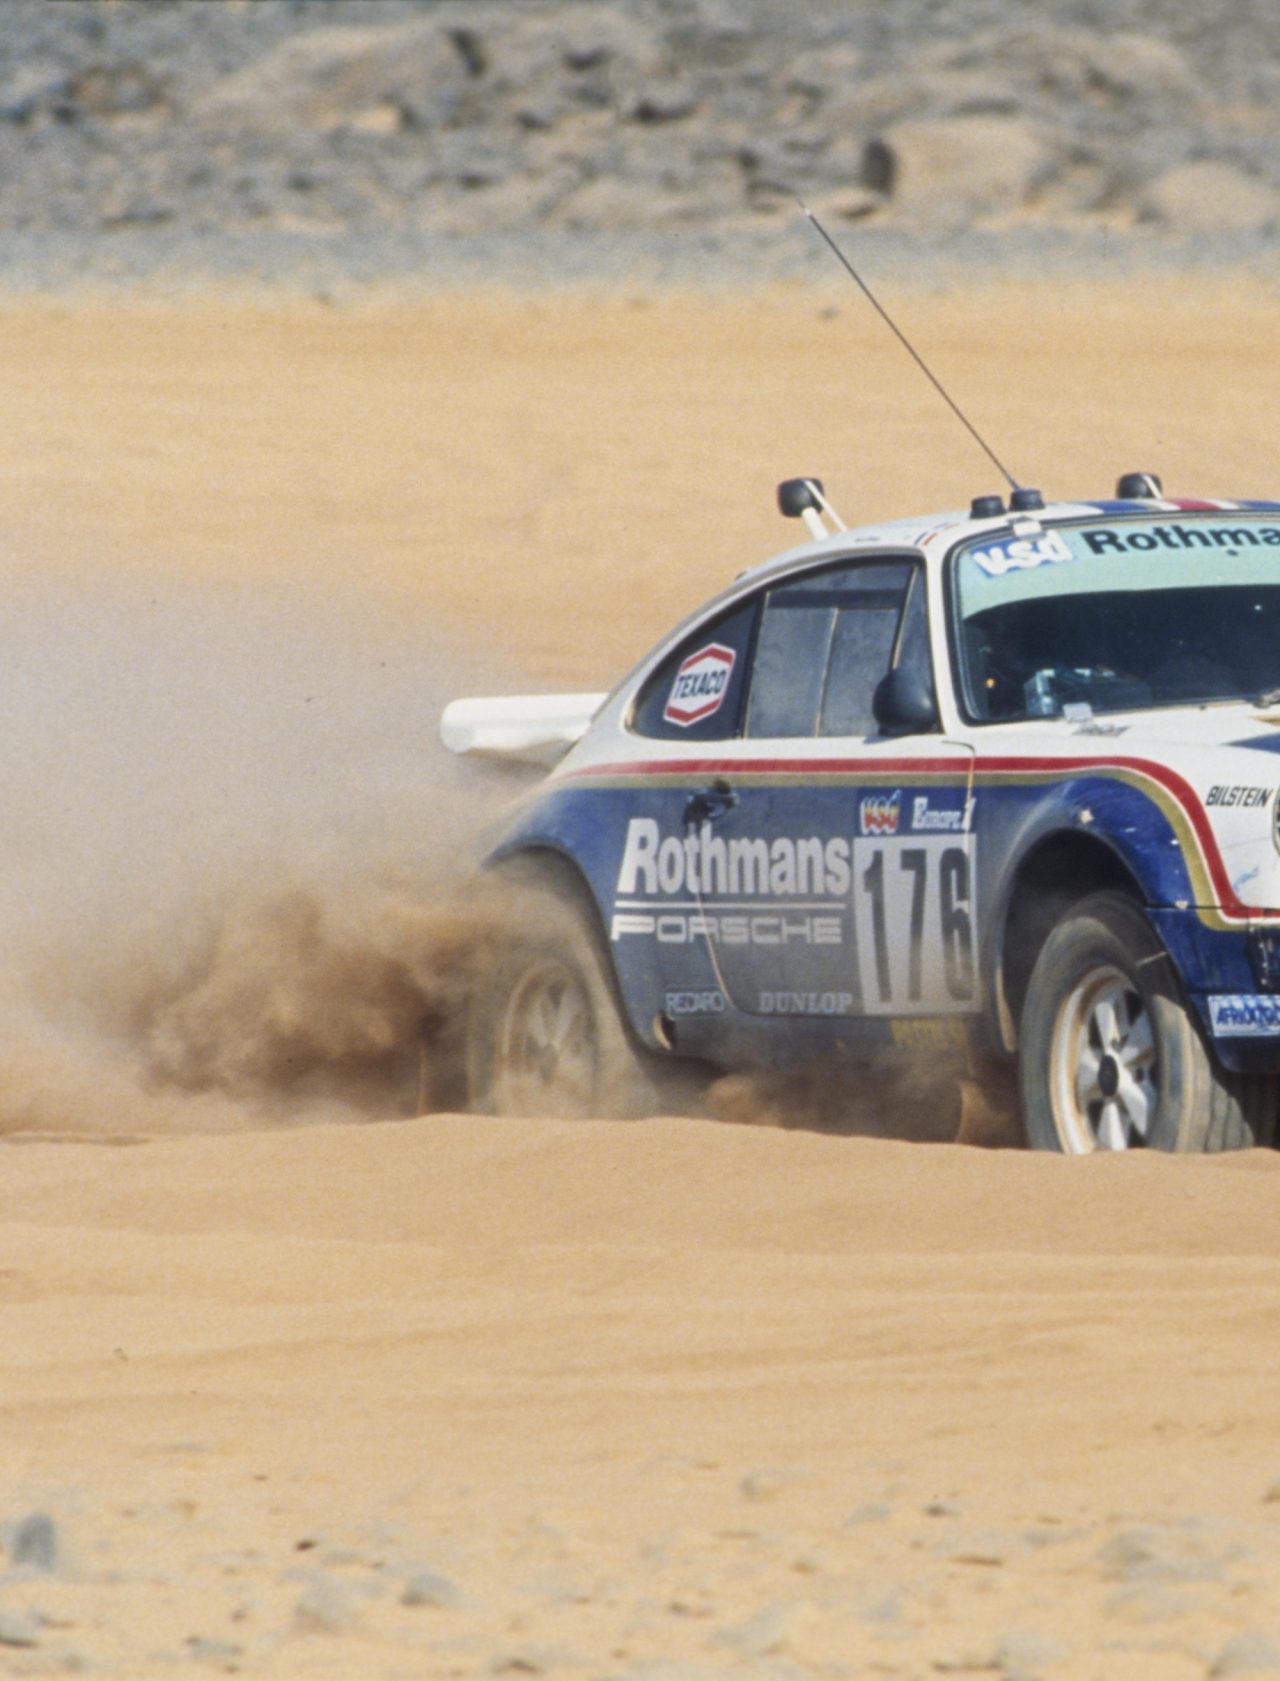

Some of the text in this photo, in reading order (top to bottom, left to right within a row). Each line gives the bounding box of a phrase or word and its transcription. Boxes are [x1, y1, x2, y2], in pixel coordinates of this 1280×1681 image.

[674, 669, 727, 700] TEXACO
[1206, 785, 1274, 808] BILSTEIN
[616, 817, 851, 895] Rothmans
[611, 913, 843, 945] PORSCHE
[862, 846, 973, 1006] 176
[758, 991, 854, 1015] DUNLOP
